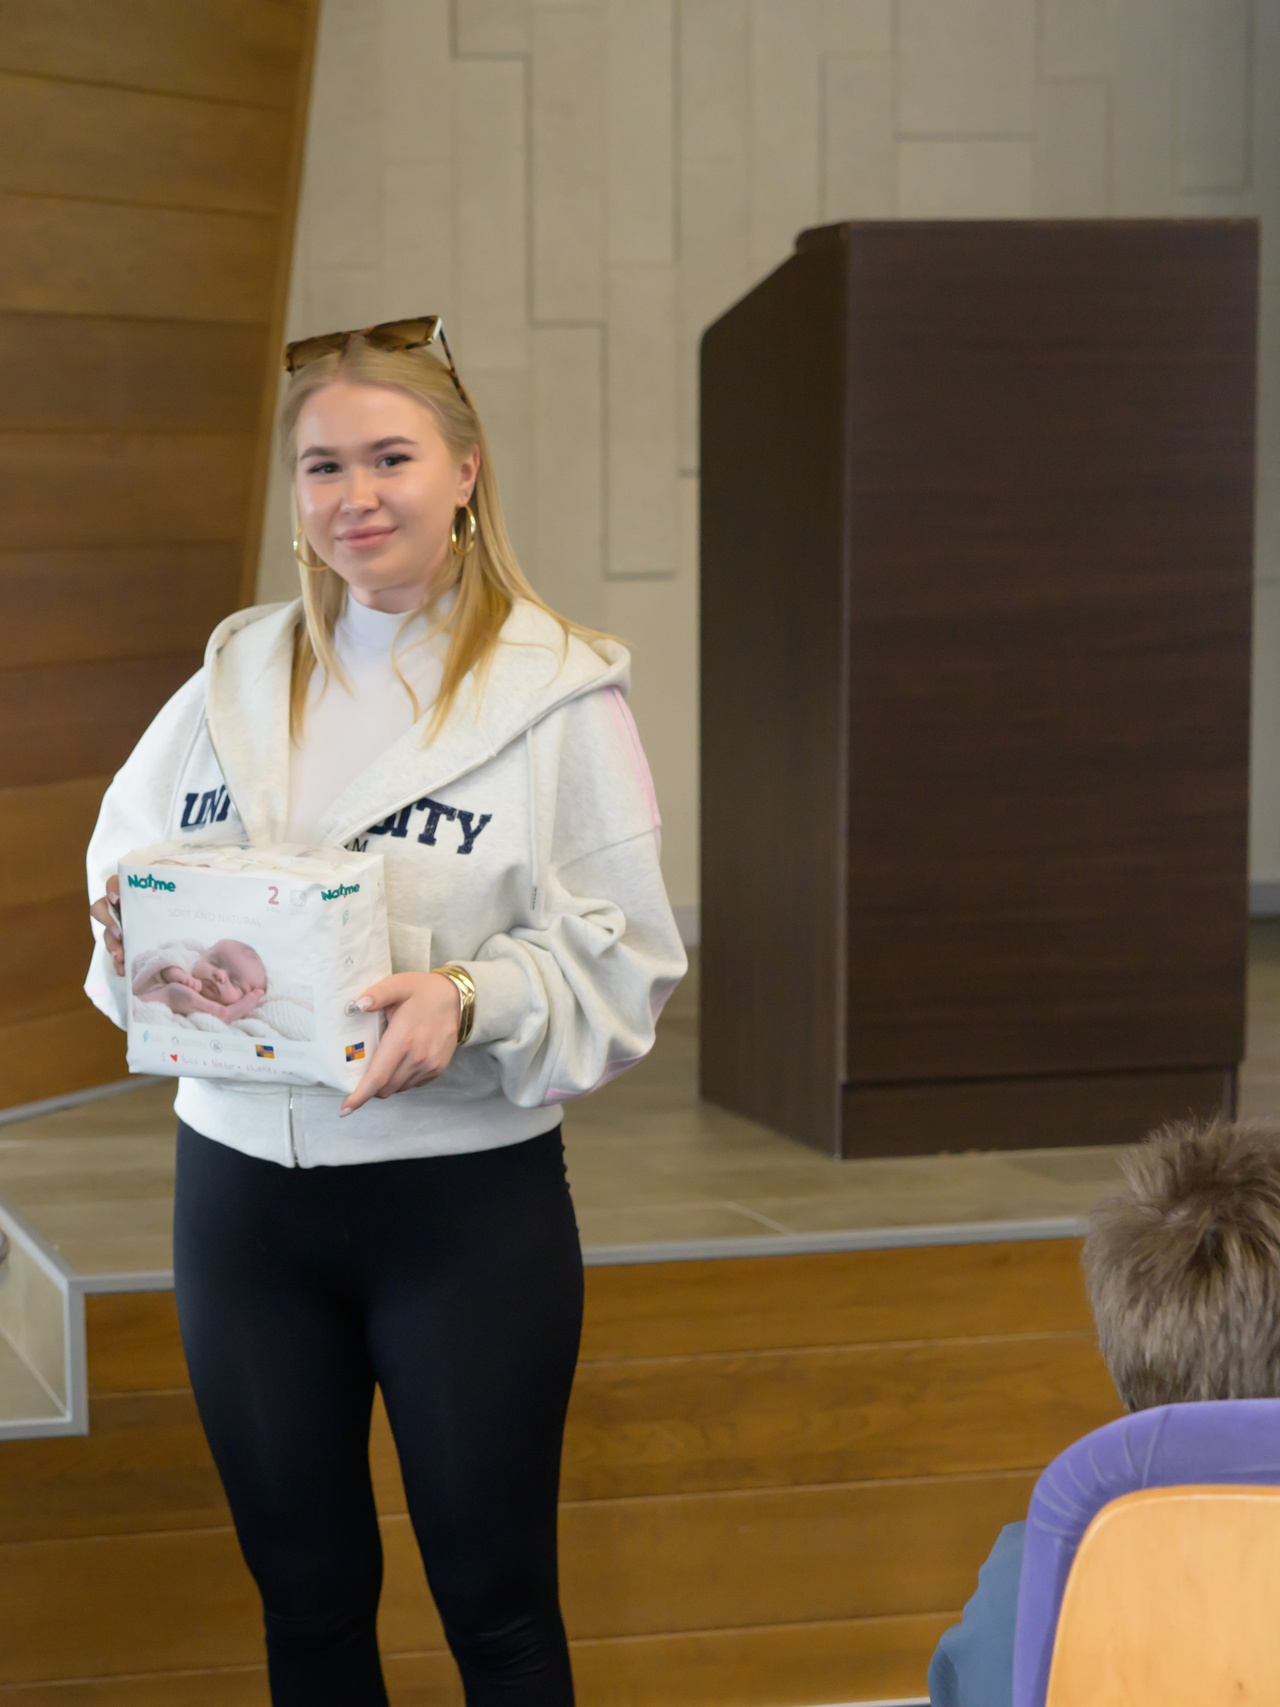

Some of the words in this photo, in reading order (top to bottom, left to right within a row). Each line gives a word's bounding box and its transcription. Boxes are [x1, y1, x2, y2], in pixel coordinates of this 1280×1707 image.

[267, 885, 280, 905] 2
[168, 908, 191, 919] SOFT
[194, 911, 216, 922] AND
[218, 914, 263, 927] NATURAL
